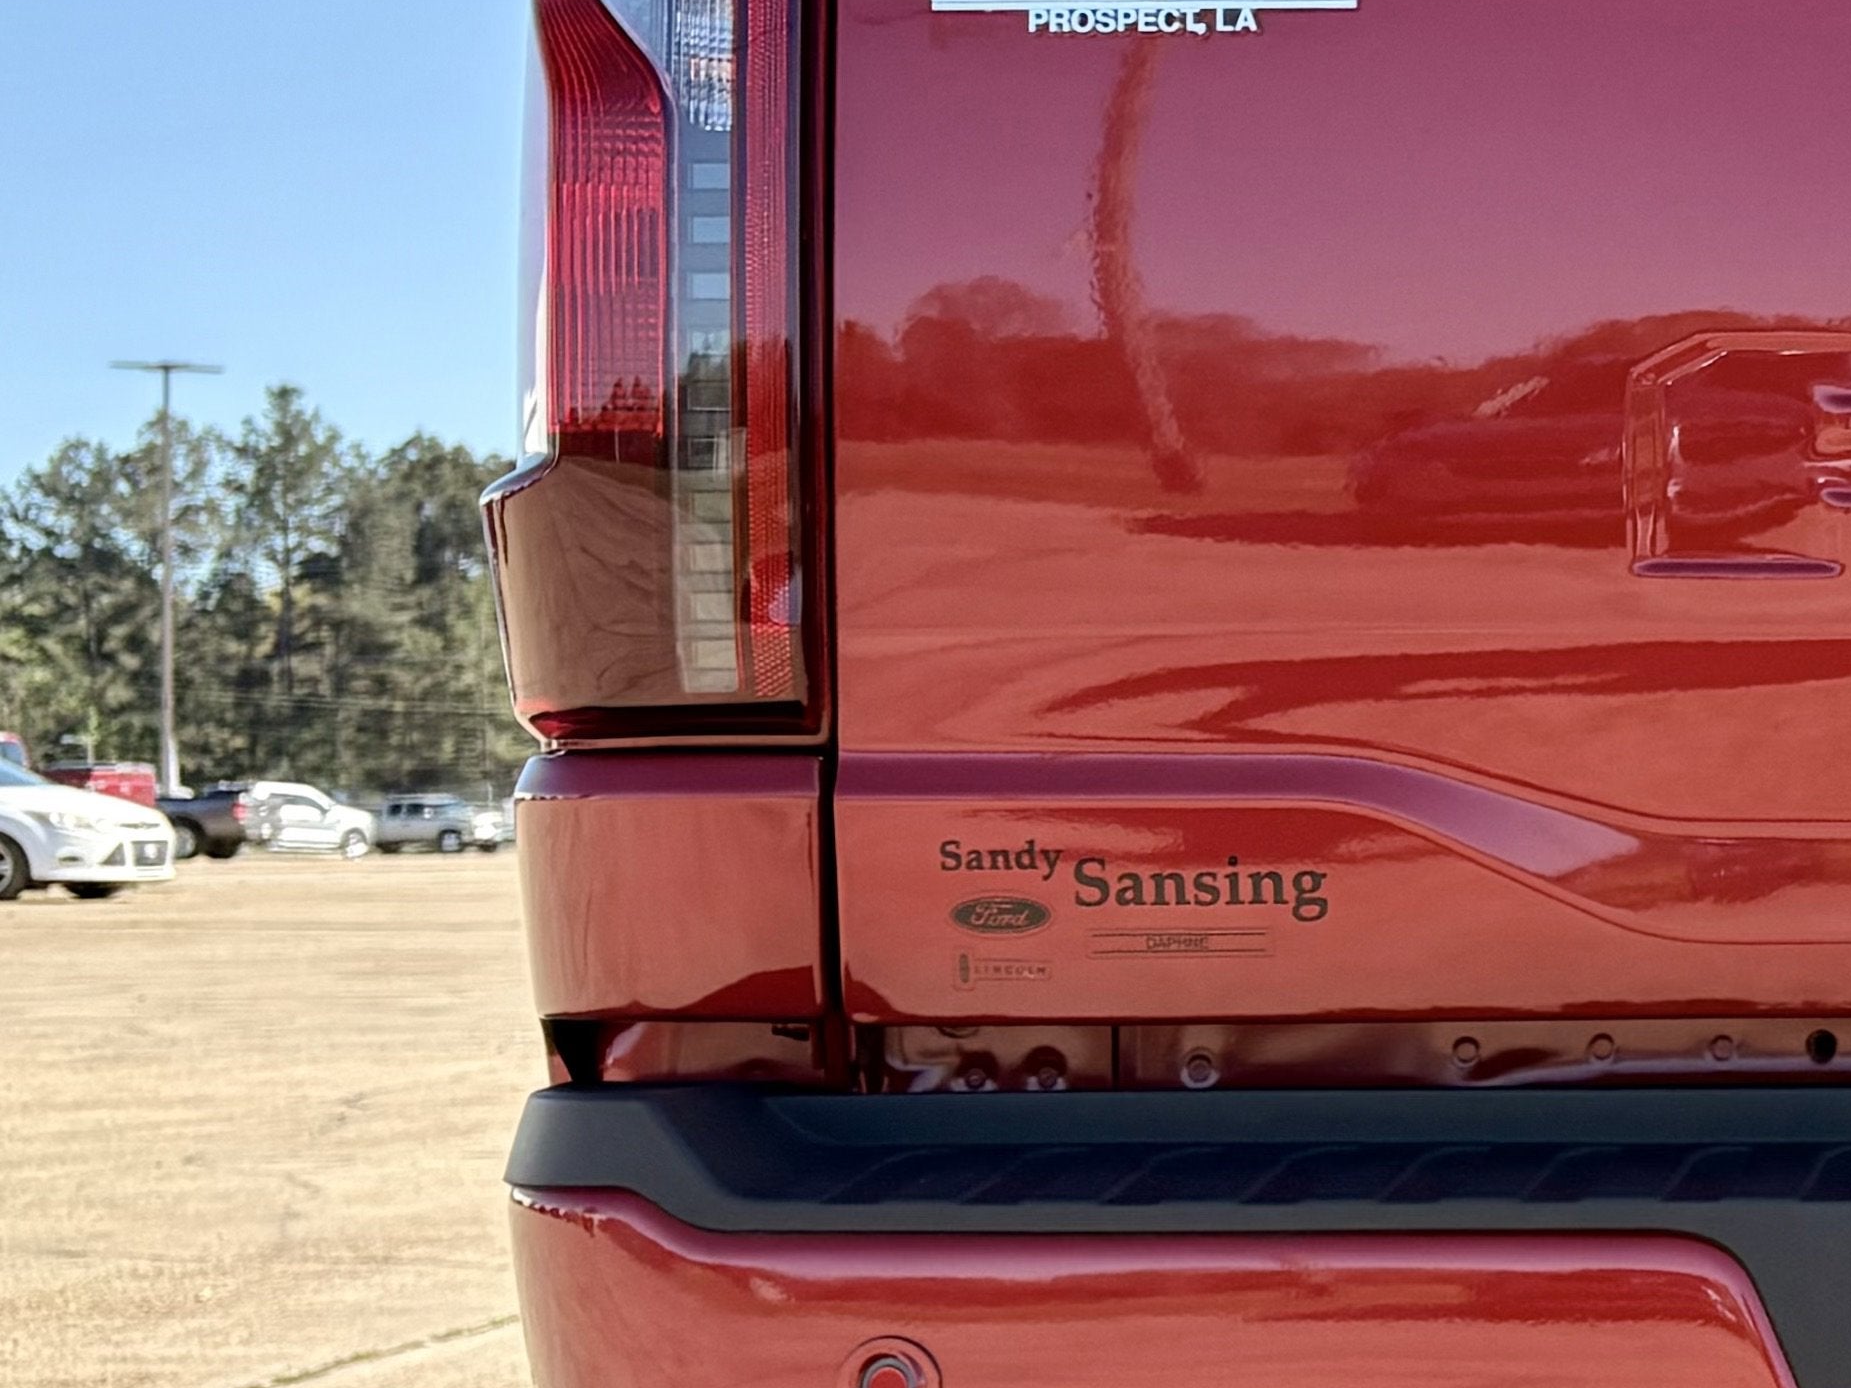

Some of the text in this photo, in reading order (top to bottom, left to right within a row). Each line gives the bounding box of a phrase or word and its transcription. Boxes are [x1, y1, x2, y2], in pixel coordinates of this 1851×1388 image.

[1215, 8, 1258, 32] LA
[940, 839, 1329, 921] Sandy Sansing
